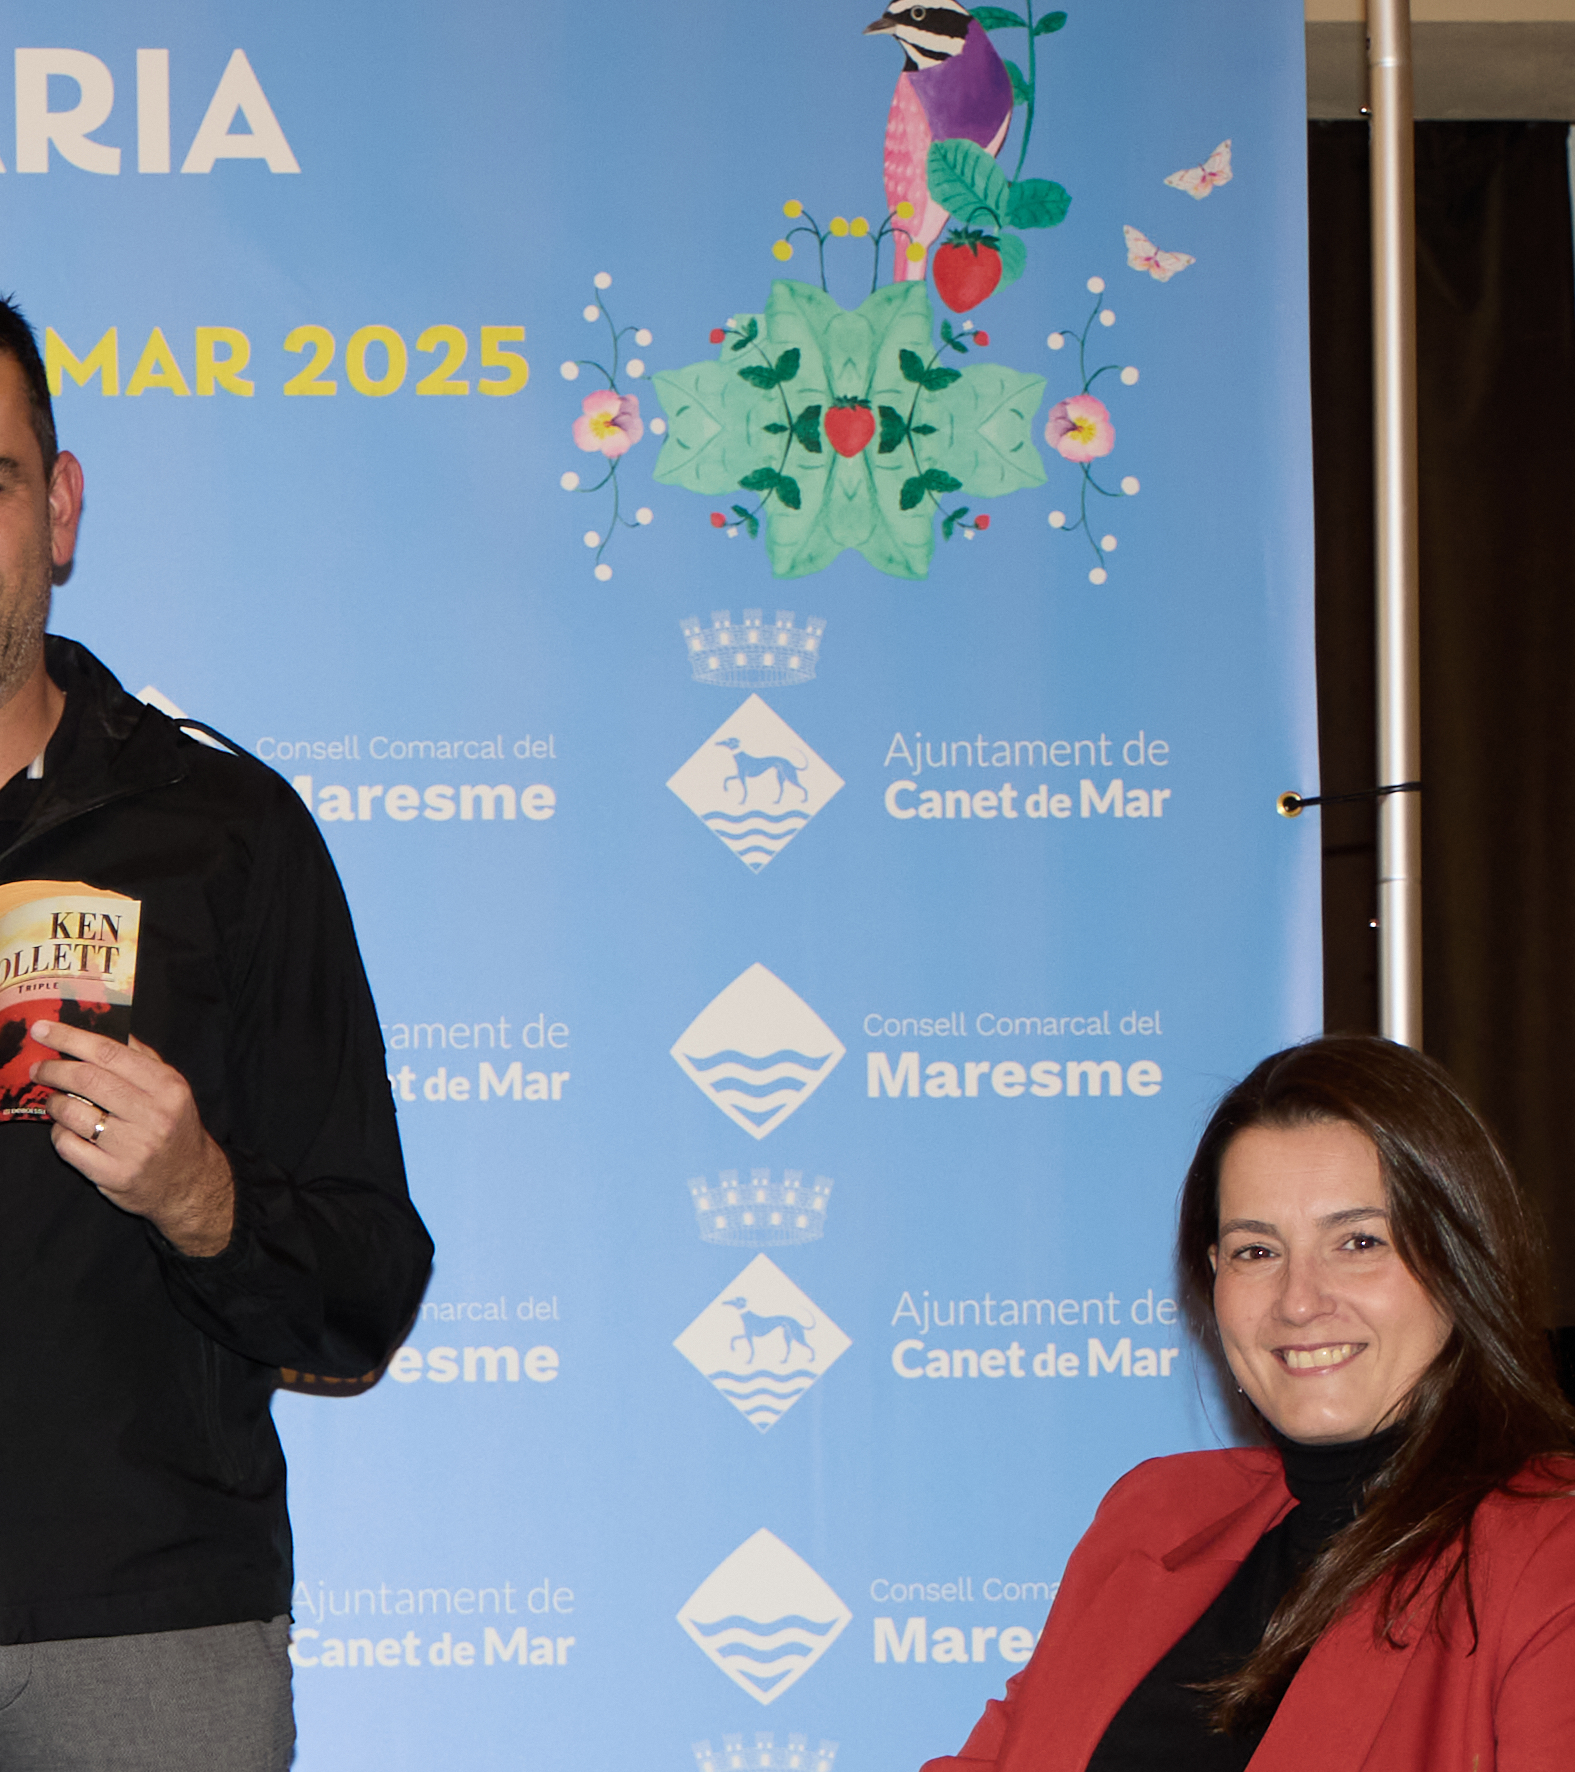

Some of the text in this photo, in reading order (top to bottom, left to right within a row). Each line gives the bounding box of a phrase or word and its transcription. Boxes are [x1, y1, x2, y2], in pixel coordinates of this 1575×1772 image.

[46, 327, 253, 396] MAR
[284, 325, 528, 396] 2025
[255, 734, 556, 761] Consell Comarcal del
[884, 730, 1170, 776] Ajuntament de
[885, 779, 1171, 819] Canet de Mar
[49, 911, 122, 942] KEN
[18, 981, 59, 994] TRIPLE
[863, 1011, 1163, 1037] Consell Comarcal del
[868, 1052, 1162, 1097] Maresme
[891, 1289, 1178, 1335] Ajuntament de
[388, 1345, 559, 1383] esme
[892, 1338, 1179, 1378] Canet de Mar
[293, 1578, 574, 1623] Ajuntament de
[869, 1577, 974, 1603] Consell
[290, 1627, 575, 1667] Canet de Mar
[874, 1617, 1042, 1663] Mare
